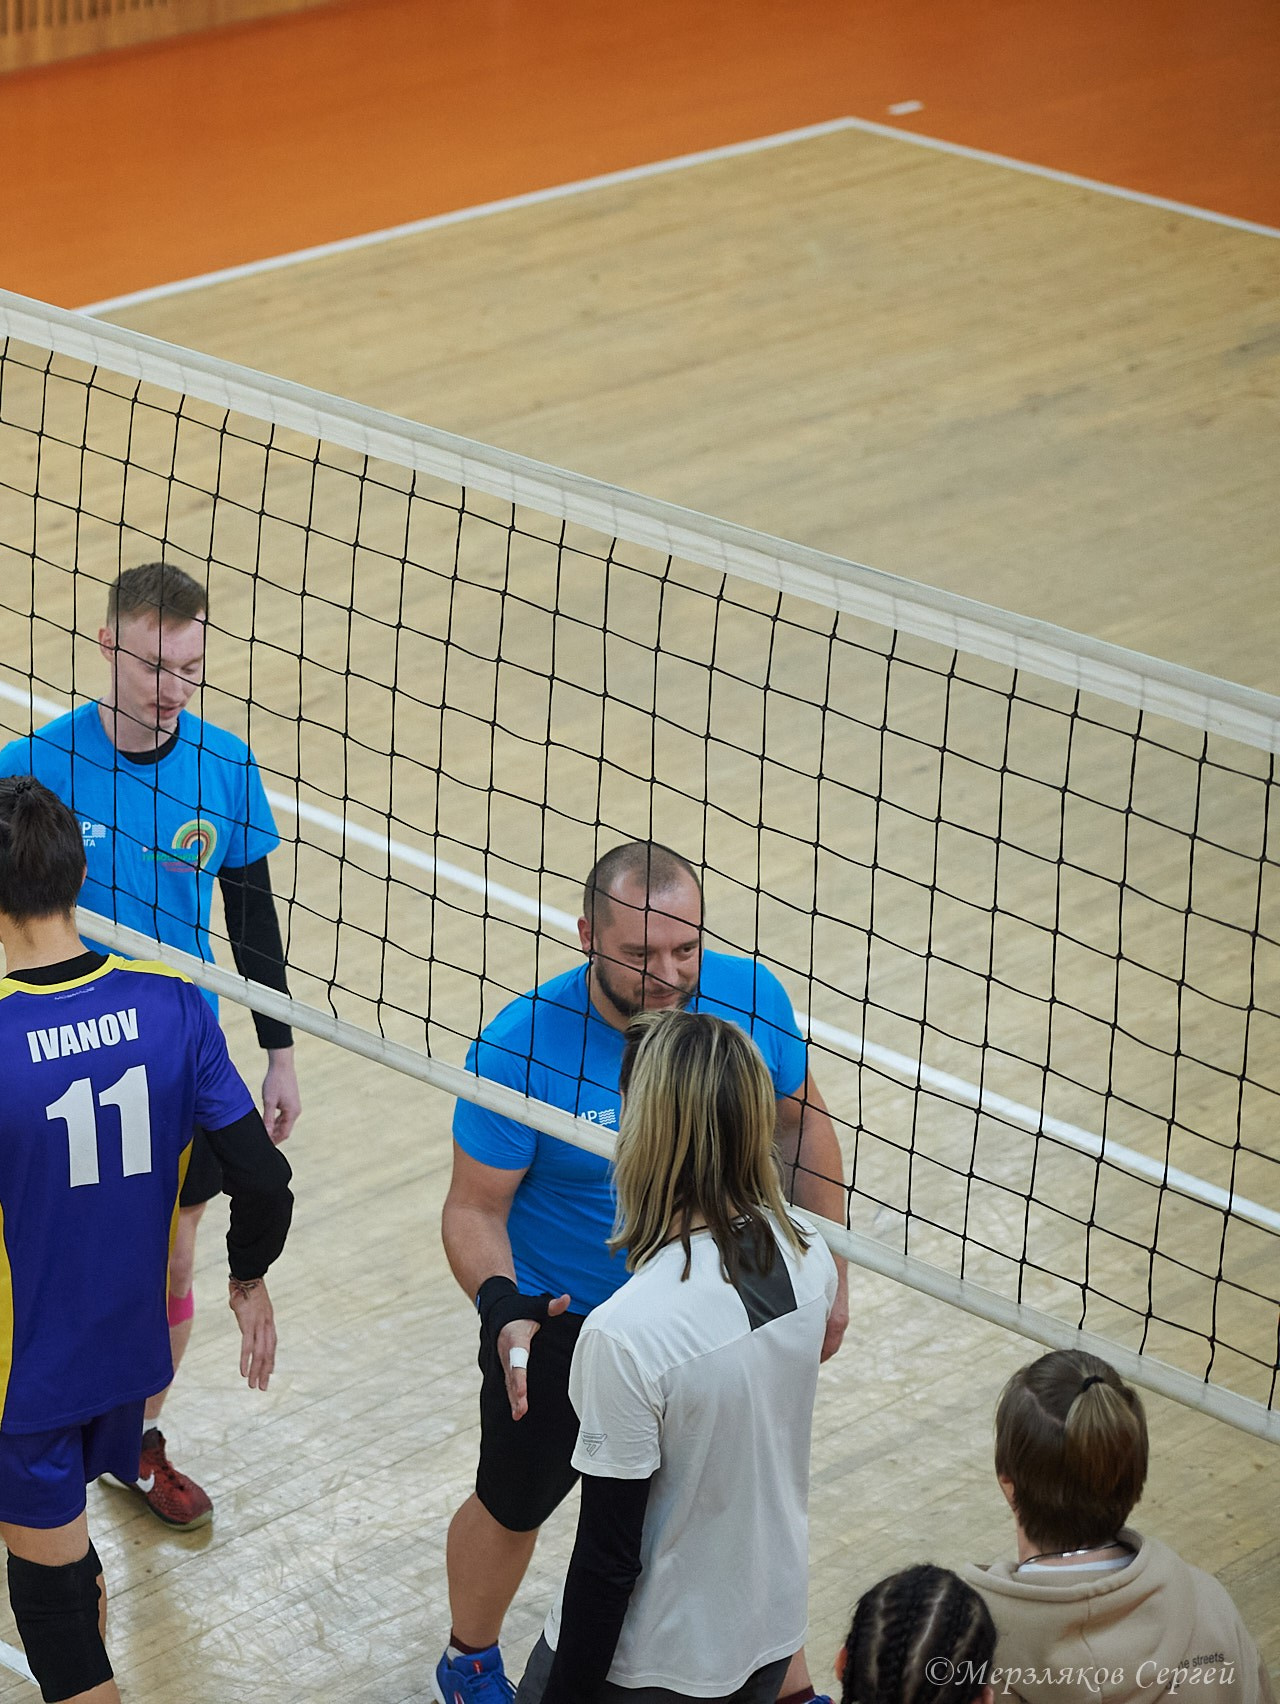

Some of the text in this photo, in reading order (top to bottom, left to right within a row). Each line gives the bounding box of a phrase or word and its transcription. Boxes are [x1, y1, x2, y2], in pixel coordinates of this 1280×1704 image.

[26, 1007, 140, 1064] IVANOV
[45, 1064, 153, 1189] 11
[1192, 1652, 1225, 1668] streets
